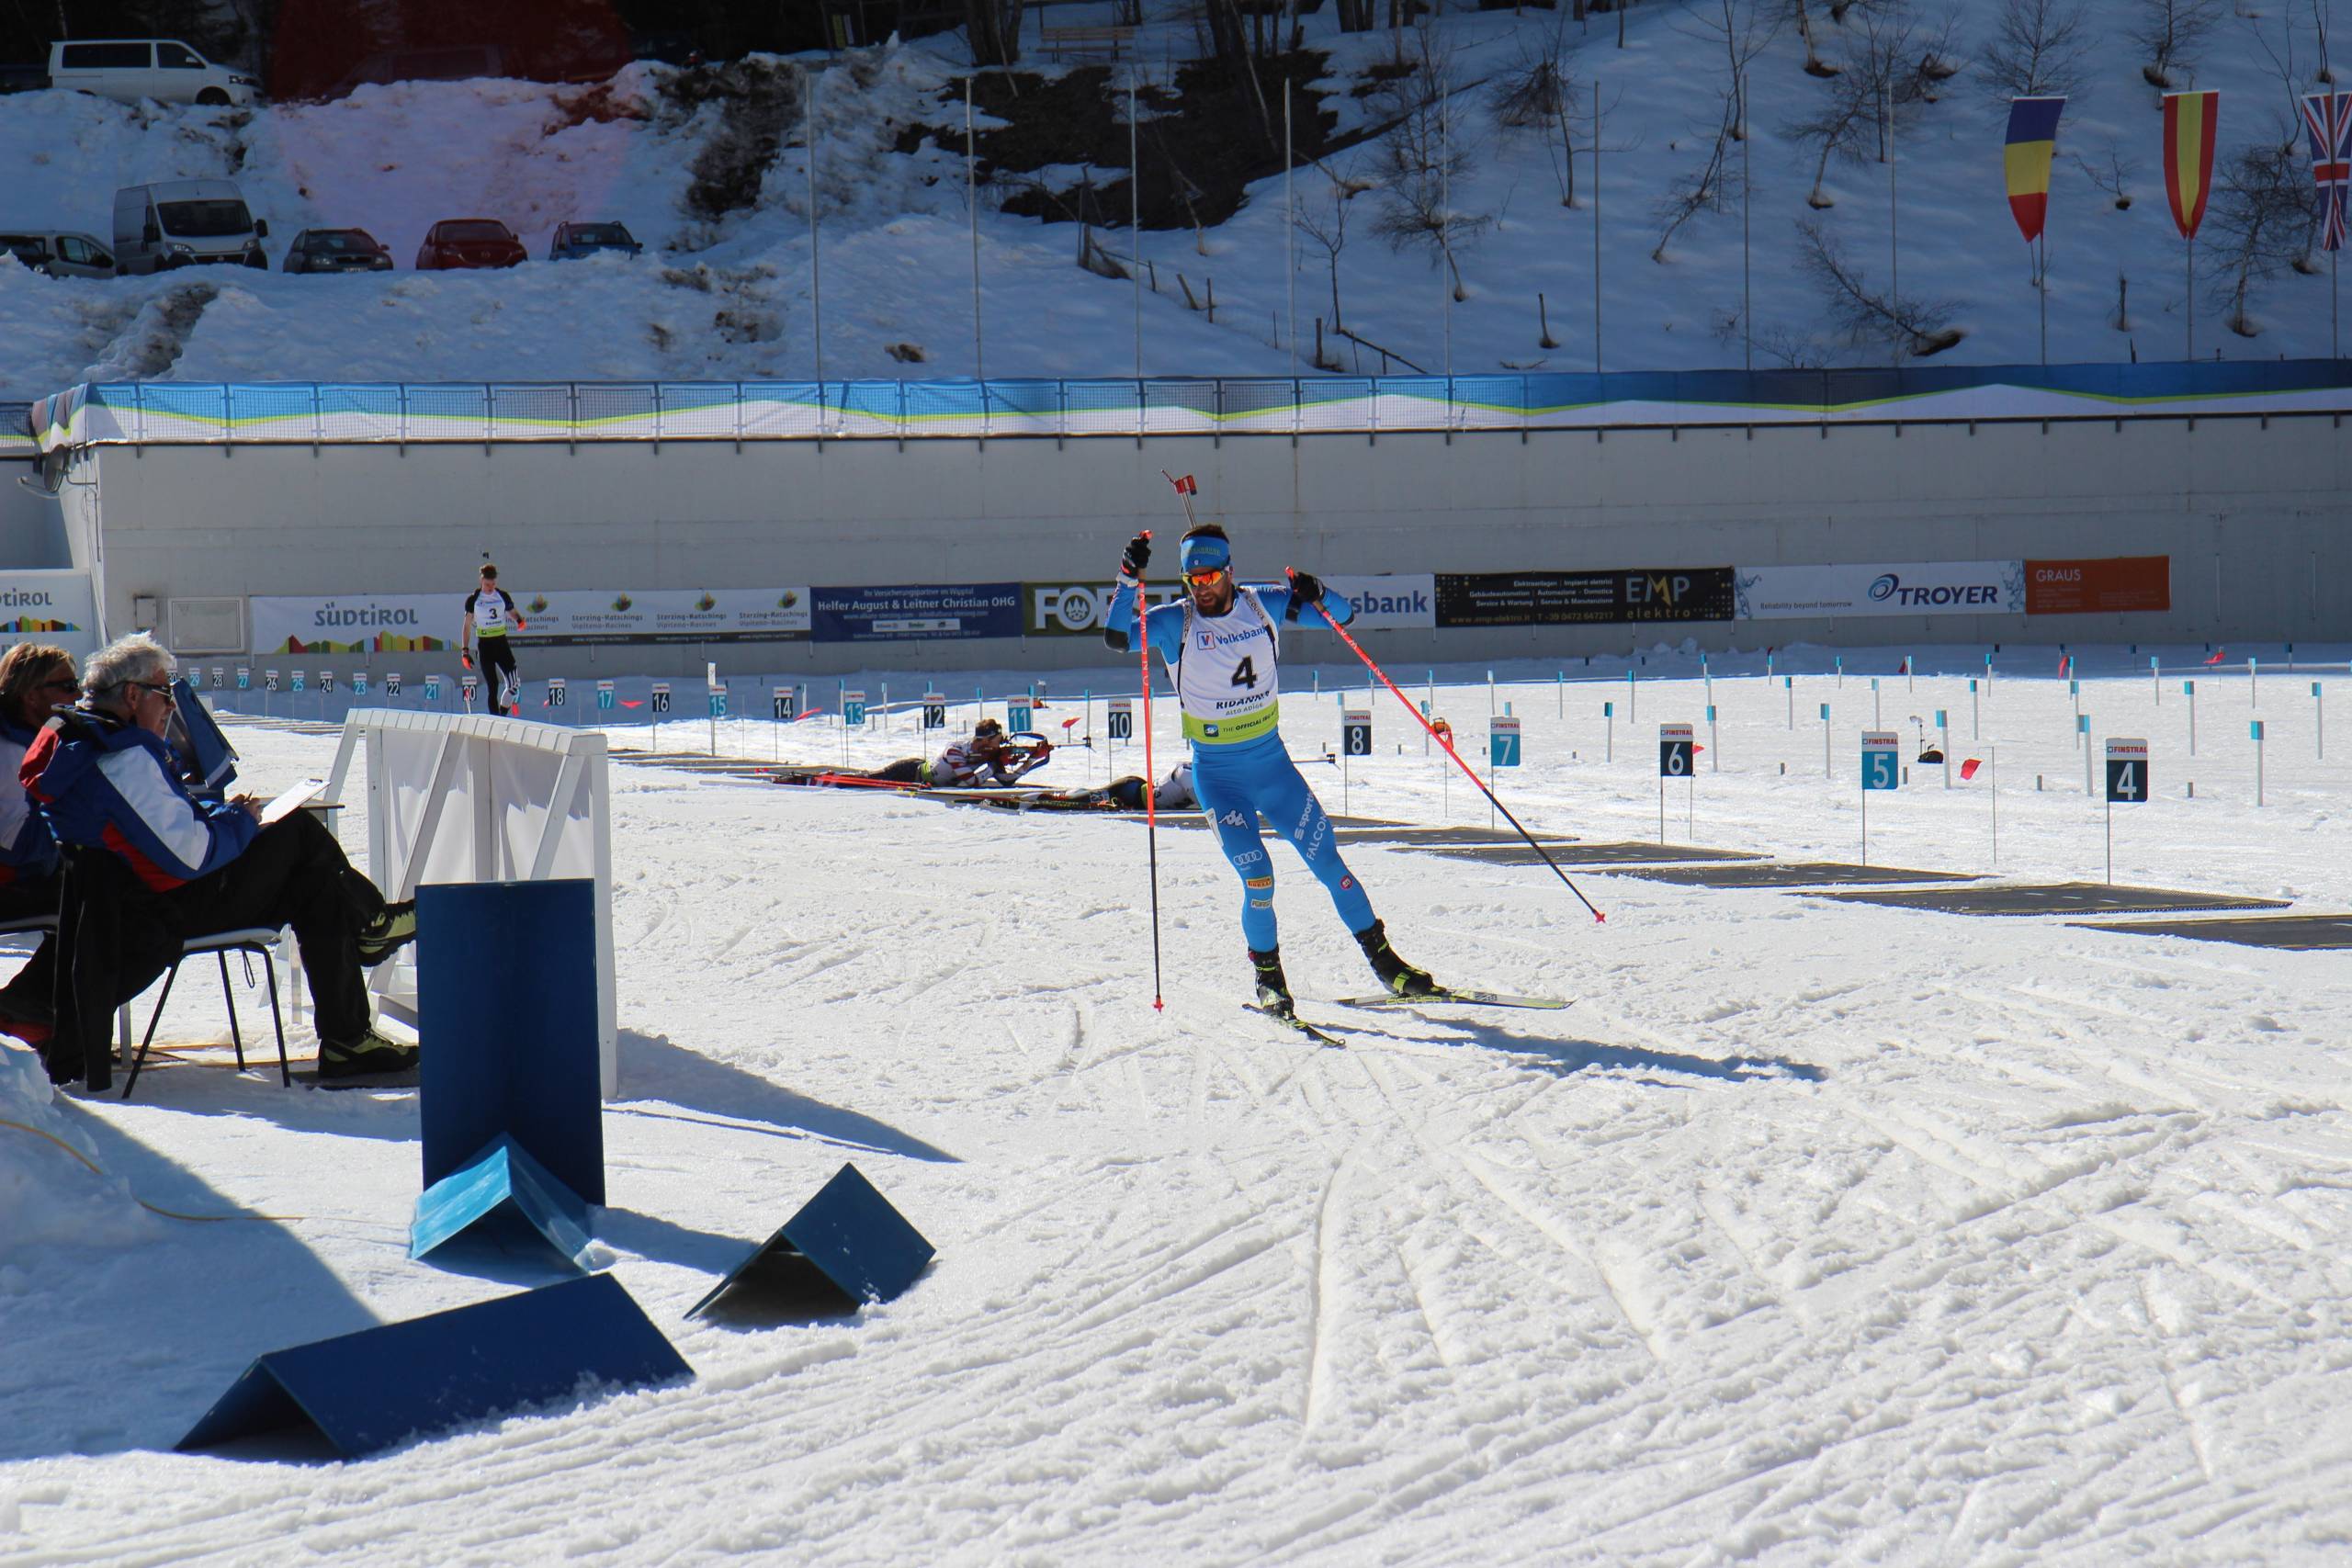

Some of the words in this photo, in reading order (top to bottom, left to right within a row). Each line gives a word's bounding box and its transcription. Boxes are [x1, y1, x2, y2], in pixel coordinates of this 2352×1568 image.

[2035, 569, 2081, 582] GRAUS
[1537, 588, 1577, 596] Automazione
[1625, 573, 1690, 606] EMP
[1897, 585, 1998, 605] TROYER
[818, 601, 850, 611] Helfer
[852, 600, 888, 613] August
[891, 600, 900, 610] &
[903, 598, 939, 609] Leitner
[943, 597, 989, 608] Christian
[991, 596, 1015, 607] OHG
[1759, 603, 1792, 611] Reliability
[1793, 602, 1818, 610] beyond
[489, 608, 498, 619] 3
[571, 613, 643, 623] Sterzing-Ratschings
[656, 613, 727, 621] Sterzing-Ratschings
[739, 611, 808, 619] Sterzing-Ratschings
[1626, 607, 1690, 619] elektro
[1216, 625, 1269, 646] Volksbank
[167, 672, 177, 683] 30
[1231, 653, 1258, 689] 4
[189, 677, 201, 687] 29
[213, 676, 223, 687] 28
[239, 678, 248, 688] 27
[266, 678, 277, 691] 26
[293, 679, 304, 691] 25
[321, 679, 333, 693] 24
[355, 682, 367, 695] 23
[388, 682, 400, 696] 22
[425, 684, 438, 699] 21
[550, 688, 564, 705] 18
[599, 691, 613, 708] 17
[653, 694, 669, 712] 16
[711, 696, 727, 715] 15
[775, 698, 792, 718] 14
[847, 703, 864, 724] 13
[924, 705, 944, 728] 12
[1010, 707, 1029, 731] 11
[1110, 713, 1130, 738] 10
[1235, 718, 1261, 731] OFFICIAL
[1351, 726, 1364, 755] 8
[1498, 736, 1513, 765] 7
[1668, 742, 1684, 775] 6
[1872, 753, 1889, 788] 5
[2116, 761, 2137, 801] 4
